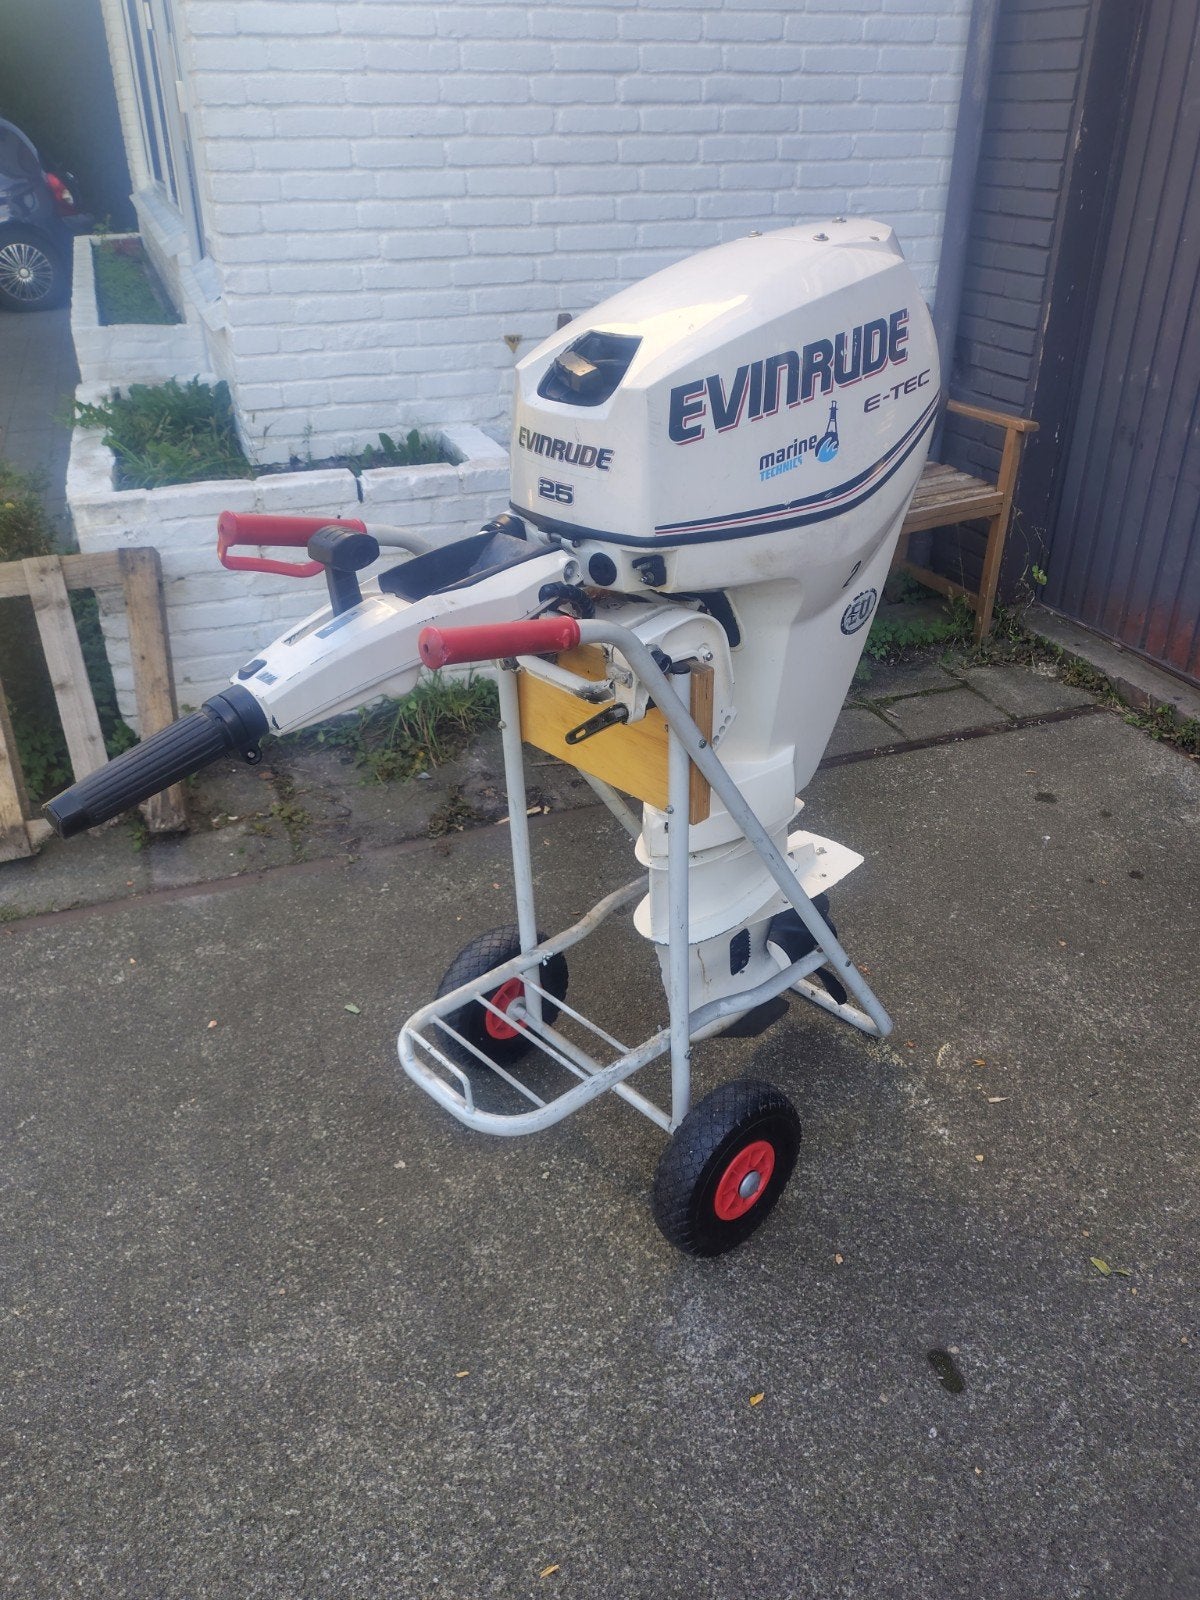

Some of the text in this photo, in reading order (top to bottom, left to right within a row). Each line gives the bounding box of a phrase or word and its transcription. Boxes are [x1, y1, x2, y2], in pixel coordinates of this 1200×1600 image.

[668, 308, 910, 445] EVINRUDE
[864, 368, 931, 413] E-TEC
[519, 426, 615, 472] EVINRUDE
[759, 434, 818, 471] marine
[538, 477, 575, 507] 25
